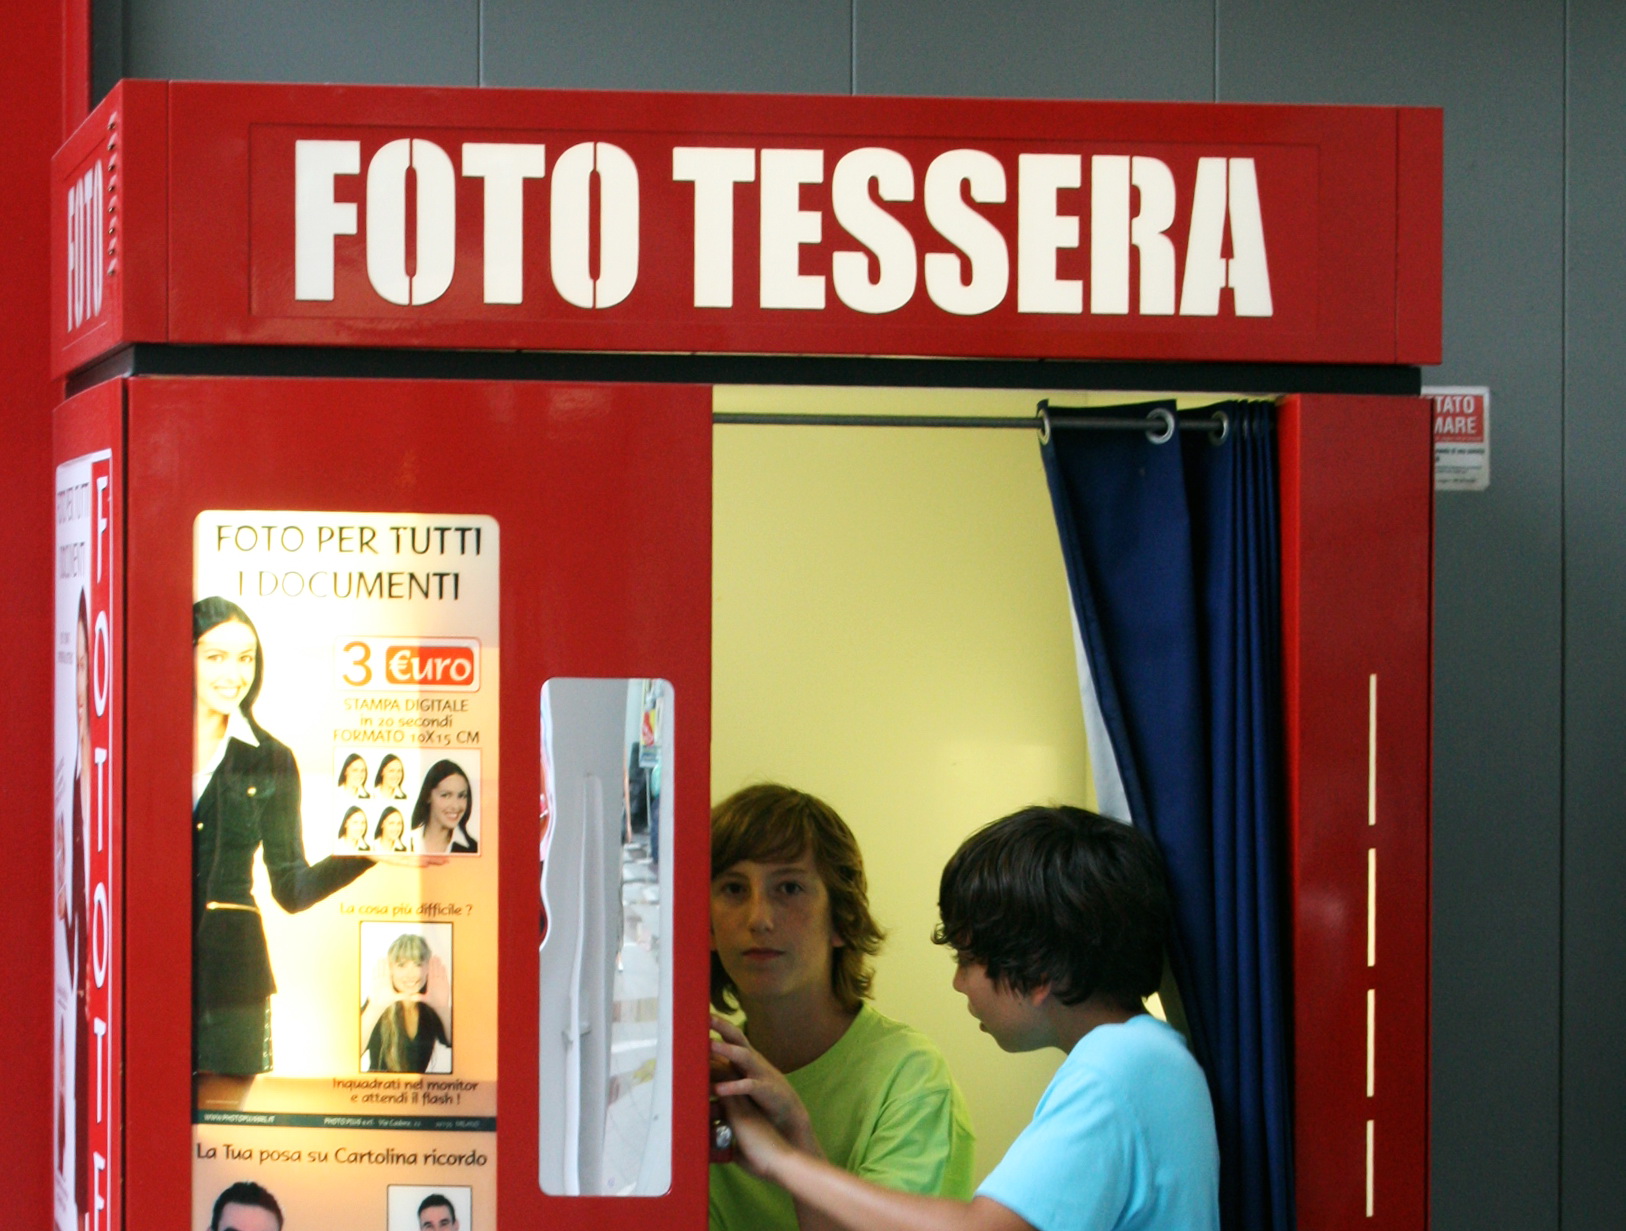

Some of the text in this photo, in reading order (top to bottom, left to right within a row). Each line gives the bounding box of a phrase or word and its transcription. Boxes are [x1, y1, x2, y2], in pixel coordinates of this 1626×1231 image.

[294, 137, 1274, 317] FOTO TESSERA
[67, 159, 103, 332] FOTO
[1434, 395, 1475, 414] TATO
[1434, 416, 1477, 435] MARE
[216, 525, 483, 556] FOTO PER TUTTI
[258, 570, 460, 601] DOCUMENTI
[342, 641, 373, 687] 3
[343, 697, 469, 713] STAMPA DIGITALE
[360, 714, 453, 728] in 20 secondi
[333, 728, 405, 743] FORMATO
[456, 730, 480, 744] CM
[340, 902, 355, 915] La
[358, 904, 389, 915] cosa
[392, 902, 412, 917] più
[416, 902, 463, 918] difficile
[332, 1077, 479, 1093] Inquadrati nel monitor
[350, 1093, 358, 1103] e
[362, 1091, 409, 1105] attendi
[411, 1091, 419, 1105] il
[422, 1092, 454, 1106] flash
[196, 1142, 488, 1166] La Tua posa su Cartolina ricordo
